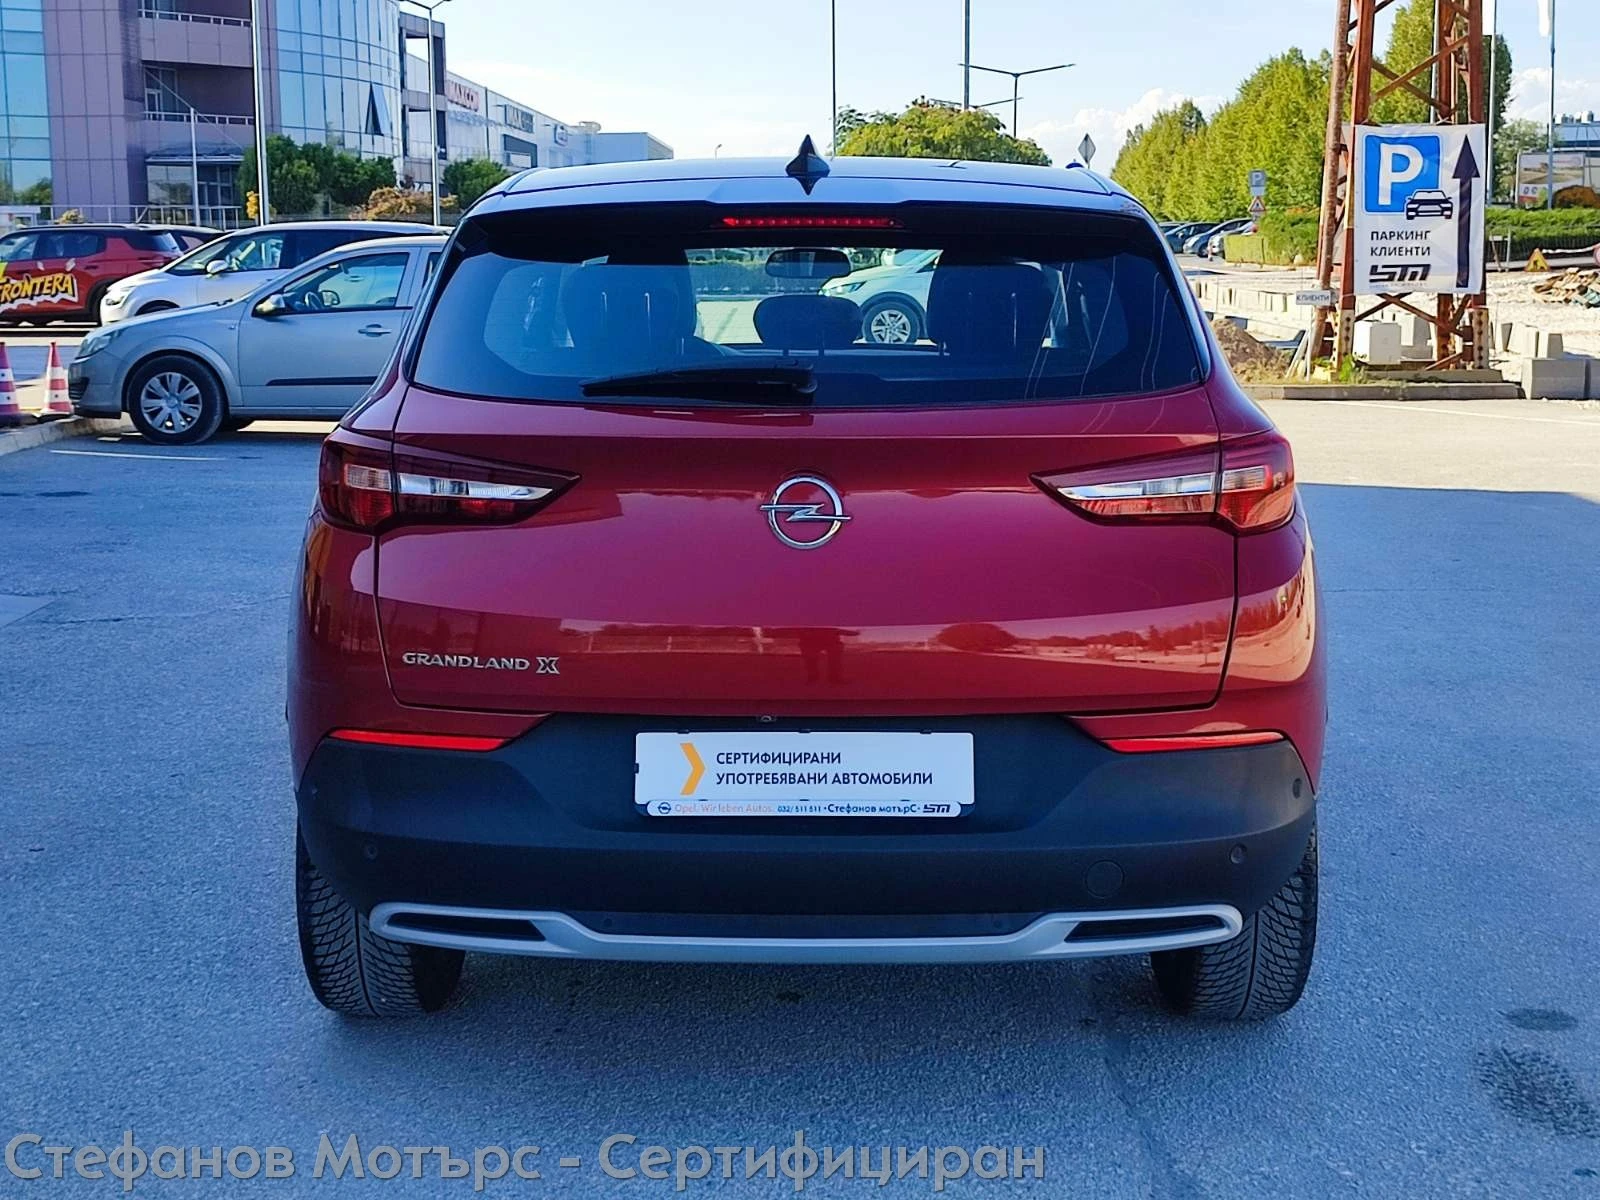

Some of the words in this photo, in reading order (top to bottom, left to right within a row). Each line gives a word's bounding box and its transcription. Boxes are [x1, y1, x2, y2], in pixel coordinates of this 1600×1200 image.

[1378, 142, 1424, 206] P
[1370, 230, 1431, 241] ПАРКИНГ
[1370, 246, 1431, 257] КЛИЕНТИ
[0, 273, 73, 303] RONTERA
[402, 652, 530, 671] GRANDLAND
[535, 656, 560, 675] X
[716, 752, 841, 766] СЕРТИФИЦИРАНИ
[716, 773, 828, 785] УПОТРЕБЯВАНИ
[831, 773, 933, 785] АВТОМОБИЛИ
